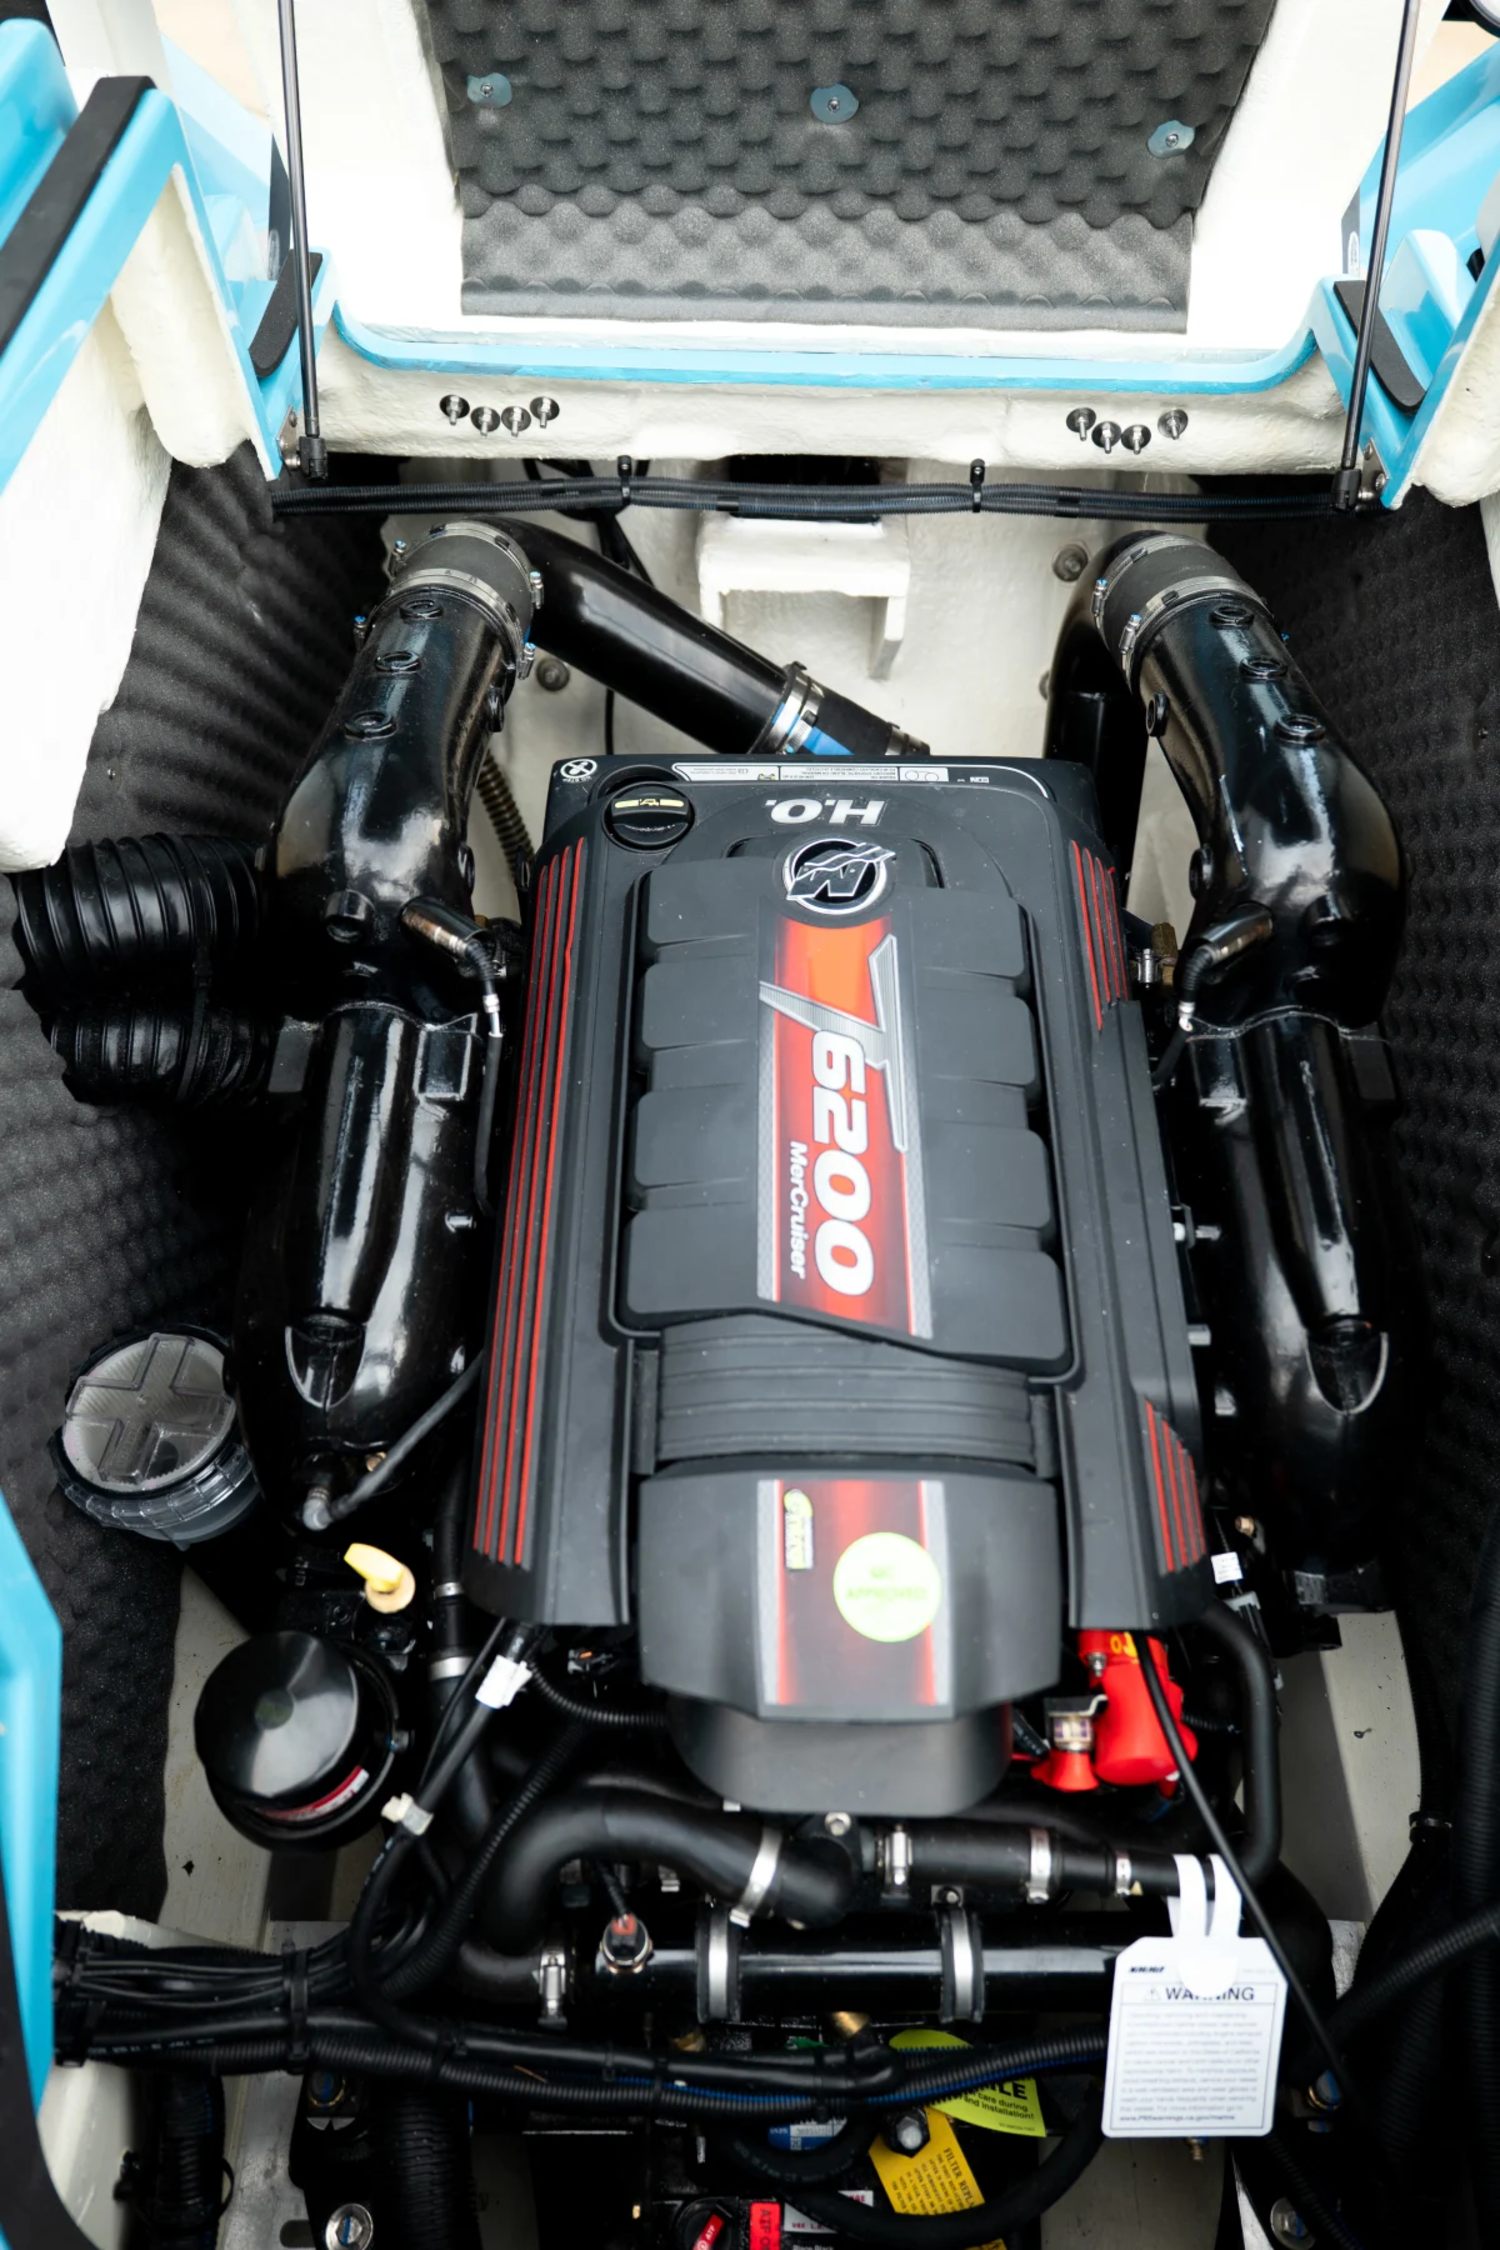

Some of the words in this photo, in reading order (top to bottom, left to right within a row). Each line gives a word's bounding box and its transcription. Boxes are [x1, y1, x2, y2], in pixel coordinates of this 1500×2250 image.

[766, 798, 886, 828] H.O.
[812, 1029, 876, 1297] 6200
[788, 1140, 810, 1280] MerCruiser
[1165, 1986, 1255, 2001] WAING
[978, 2091, 998, 2104] care
[998, 2098, 1029, 2113] during
[943, 2147, 962, 2179] FILTER
[706, 2224, 717, 2241] ATF
[760, 2208, 771, 2234] ATF
